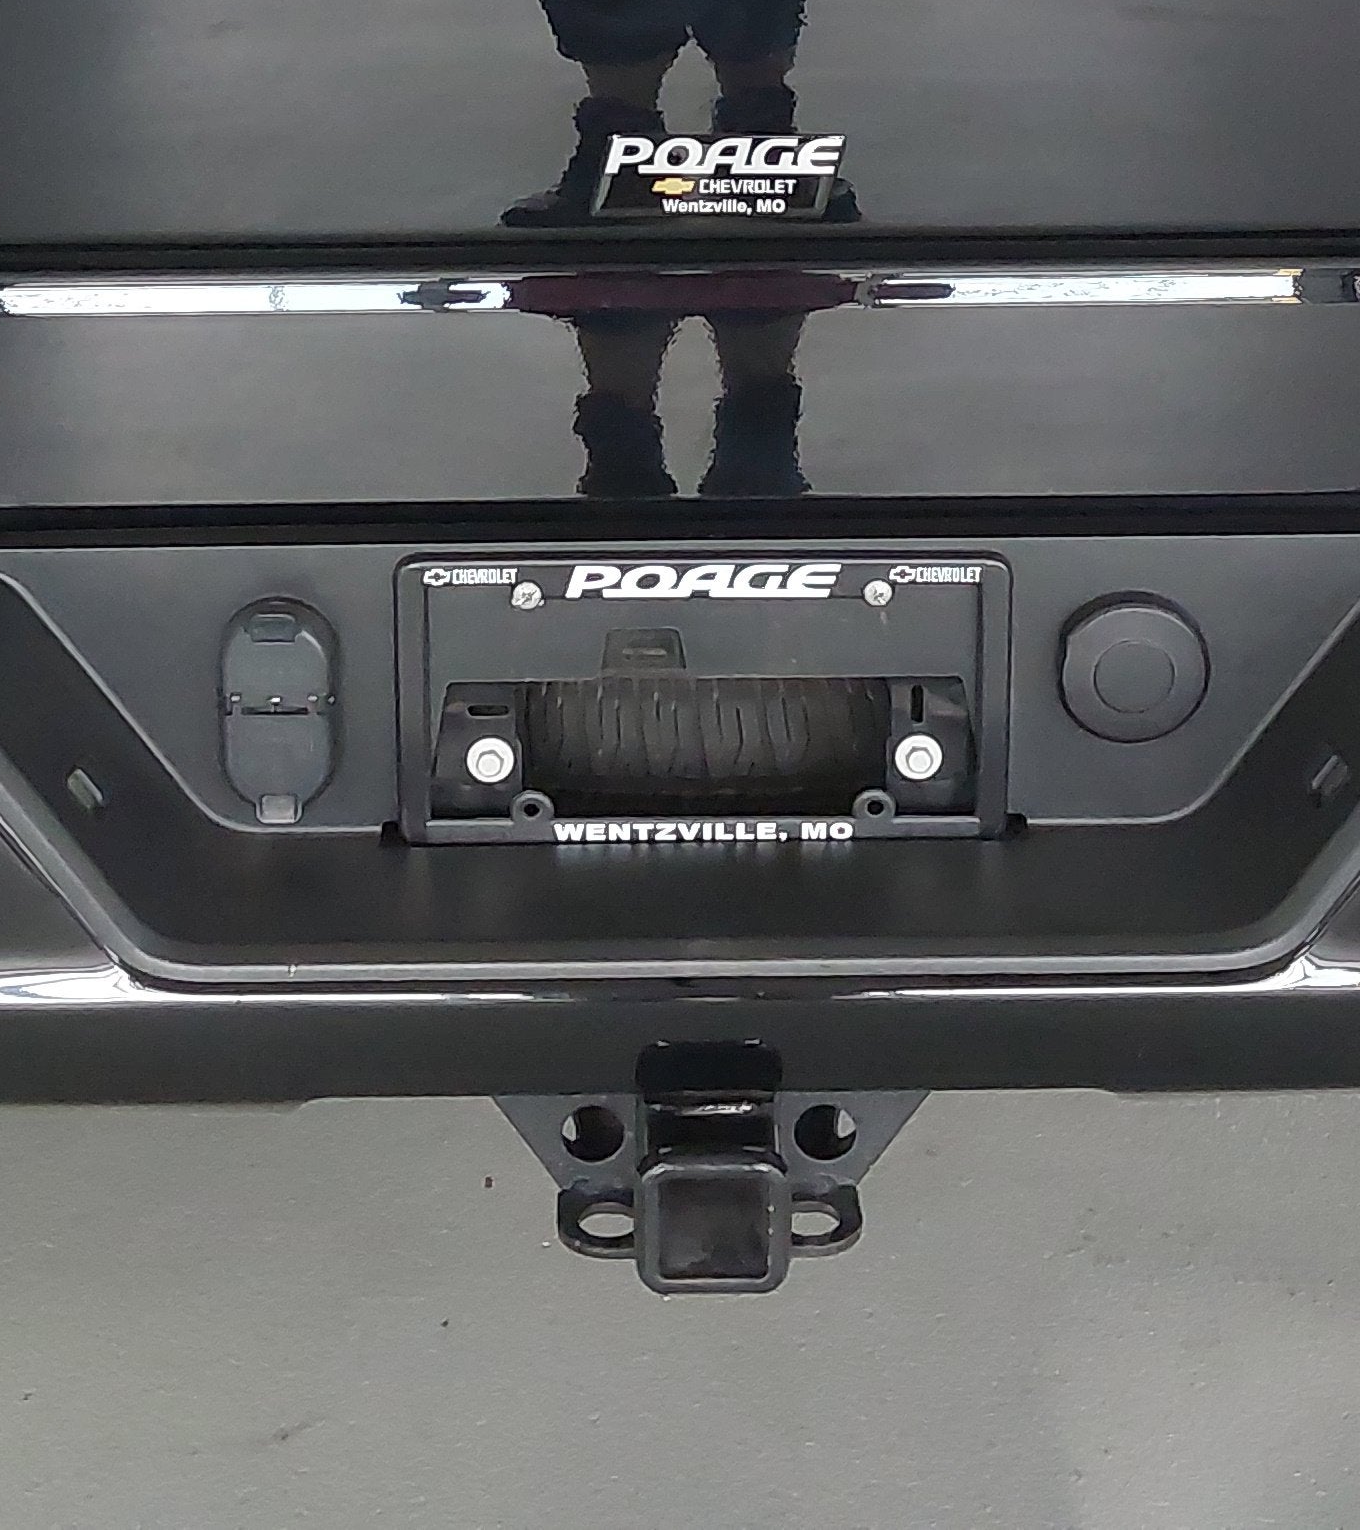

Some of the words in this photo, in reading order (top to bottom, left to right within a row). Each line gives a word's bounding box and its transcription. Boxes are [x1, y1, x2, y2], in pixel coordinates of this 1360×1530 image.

[604, 134, 845, 174] POAGE
[698, 178, 797, 194] CHEVROLET
[662, 198, 753, 215] Wentzville,
[756, 198, 787, 213] MO
[452, 568, 518, 585] CHEVROLET
[564, 564, 842, 598] POAGE
[915, 566, 982, 583] CHEVROLET
[553, 822, 789, 843] WENTZVILLE,
[800, 822, 854, 841] MO
